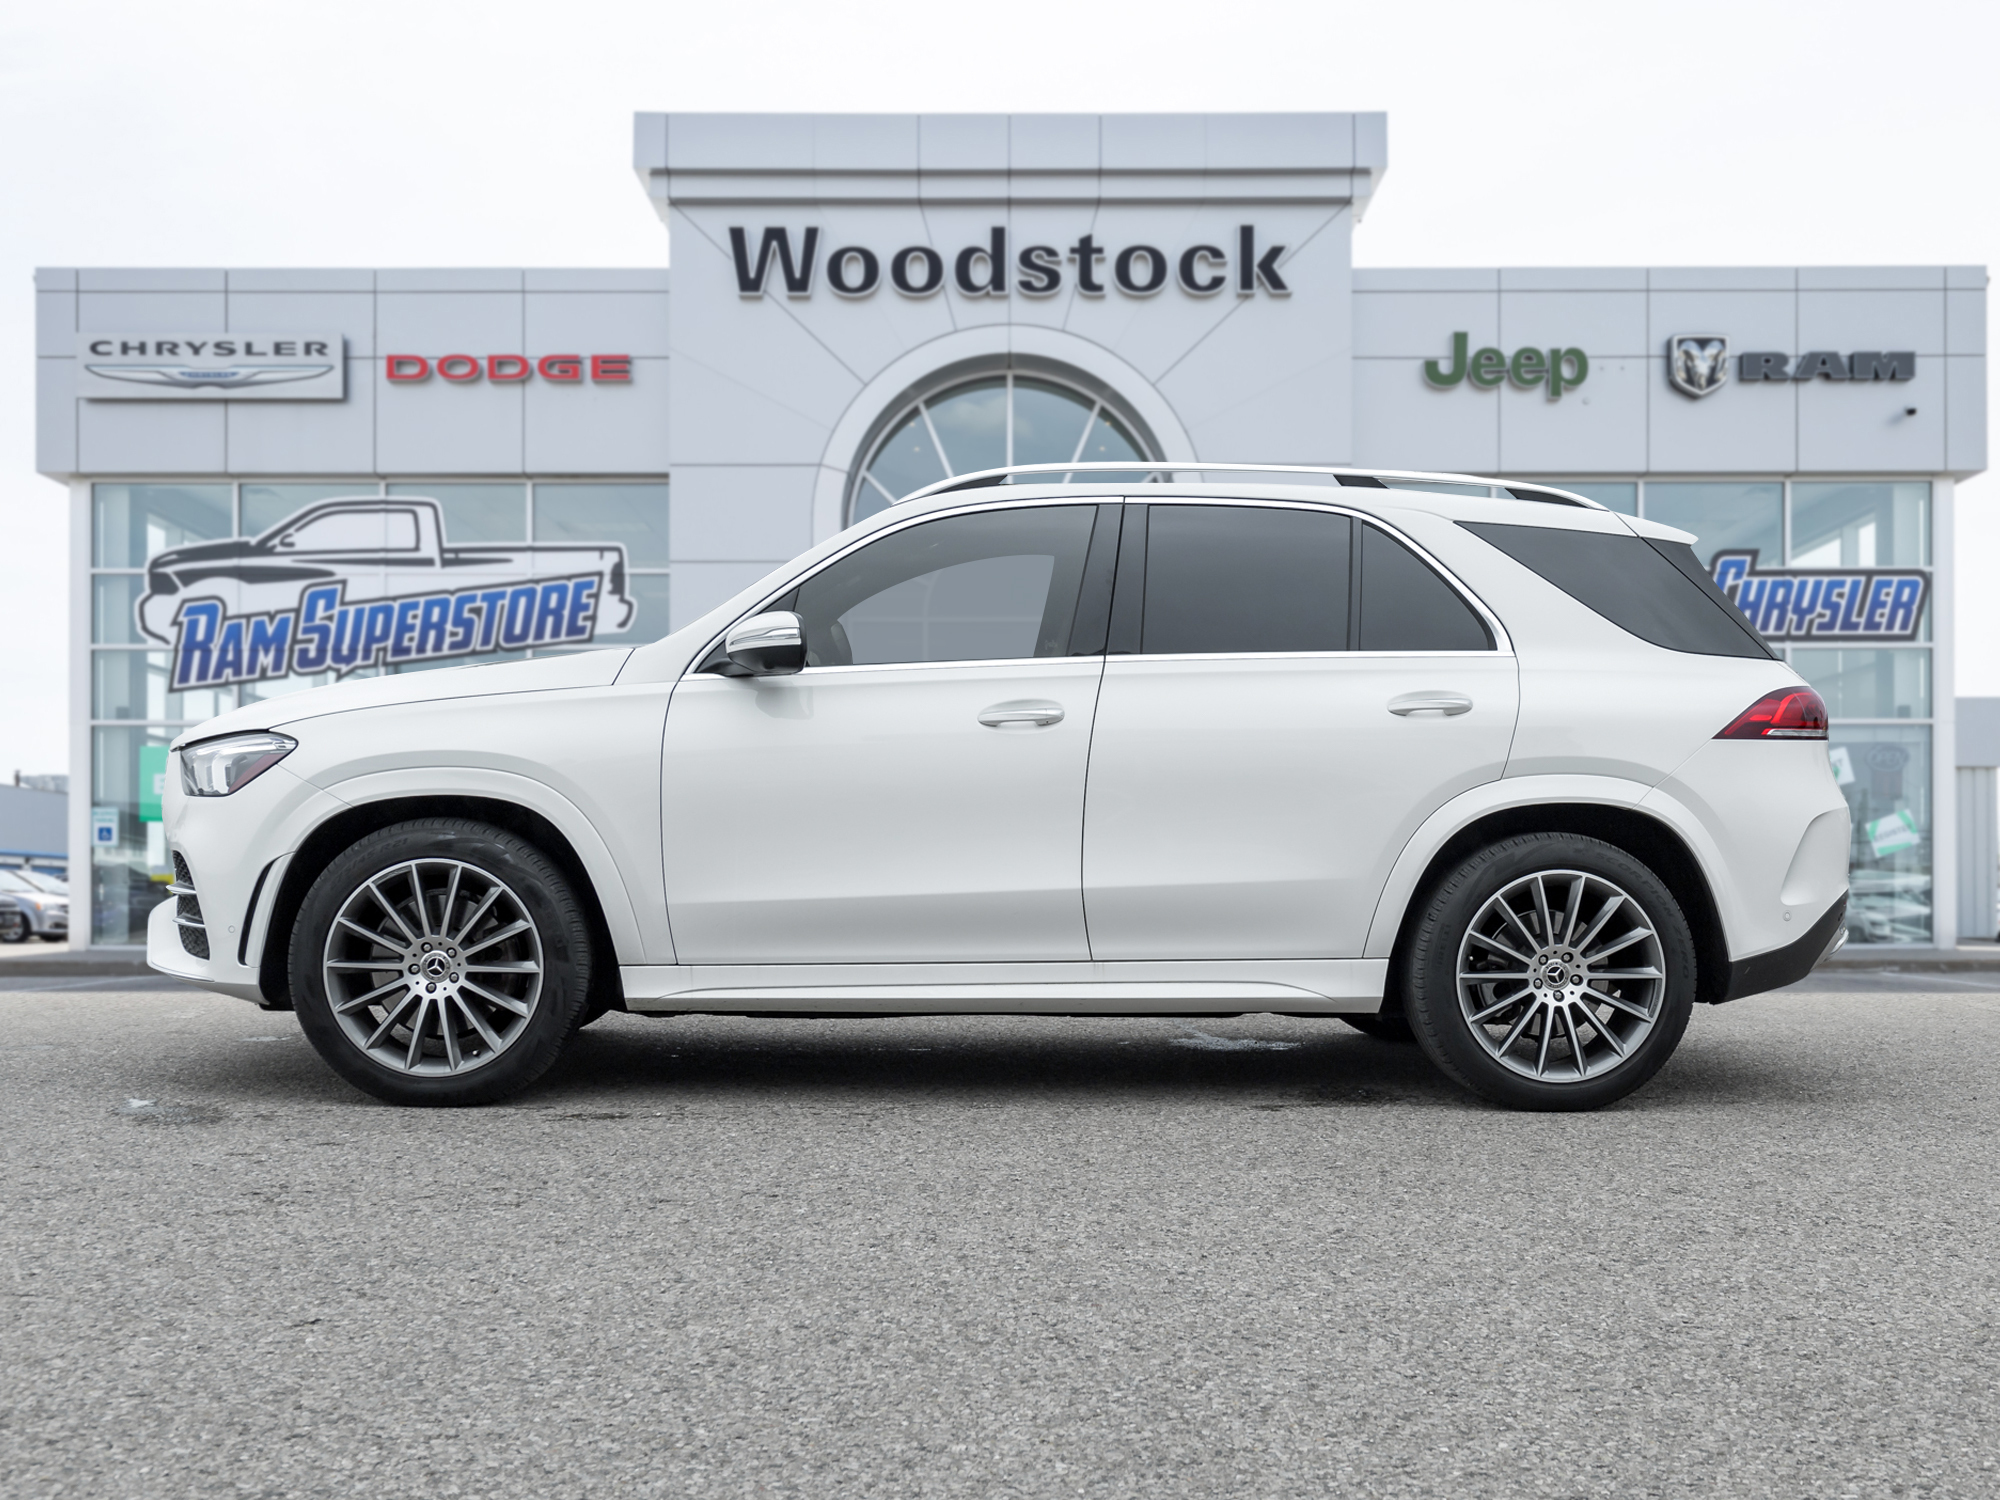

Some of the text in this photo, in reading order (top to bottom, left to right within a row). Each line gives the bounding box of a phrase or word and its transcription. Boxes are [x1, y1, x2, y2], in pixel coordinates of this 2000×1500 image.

[728, 225, 1293, 298] Woodstock
[89, 340, 329, 357] CHRYSLER
[386, 354, 633, 381] DODGE
[1424, 331, 1589, 400] Jeep
[1739, 351, 1916, 382] RAM
[173, 577, 598, 686] RAM SUPERSTORE
